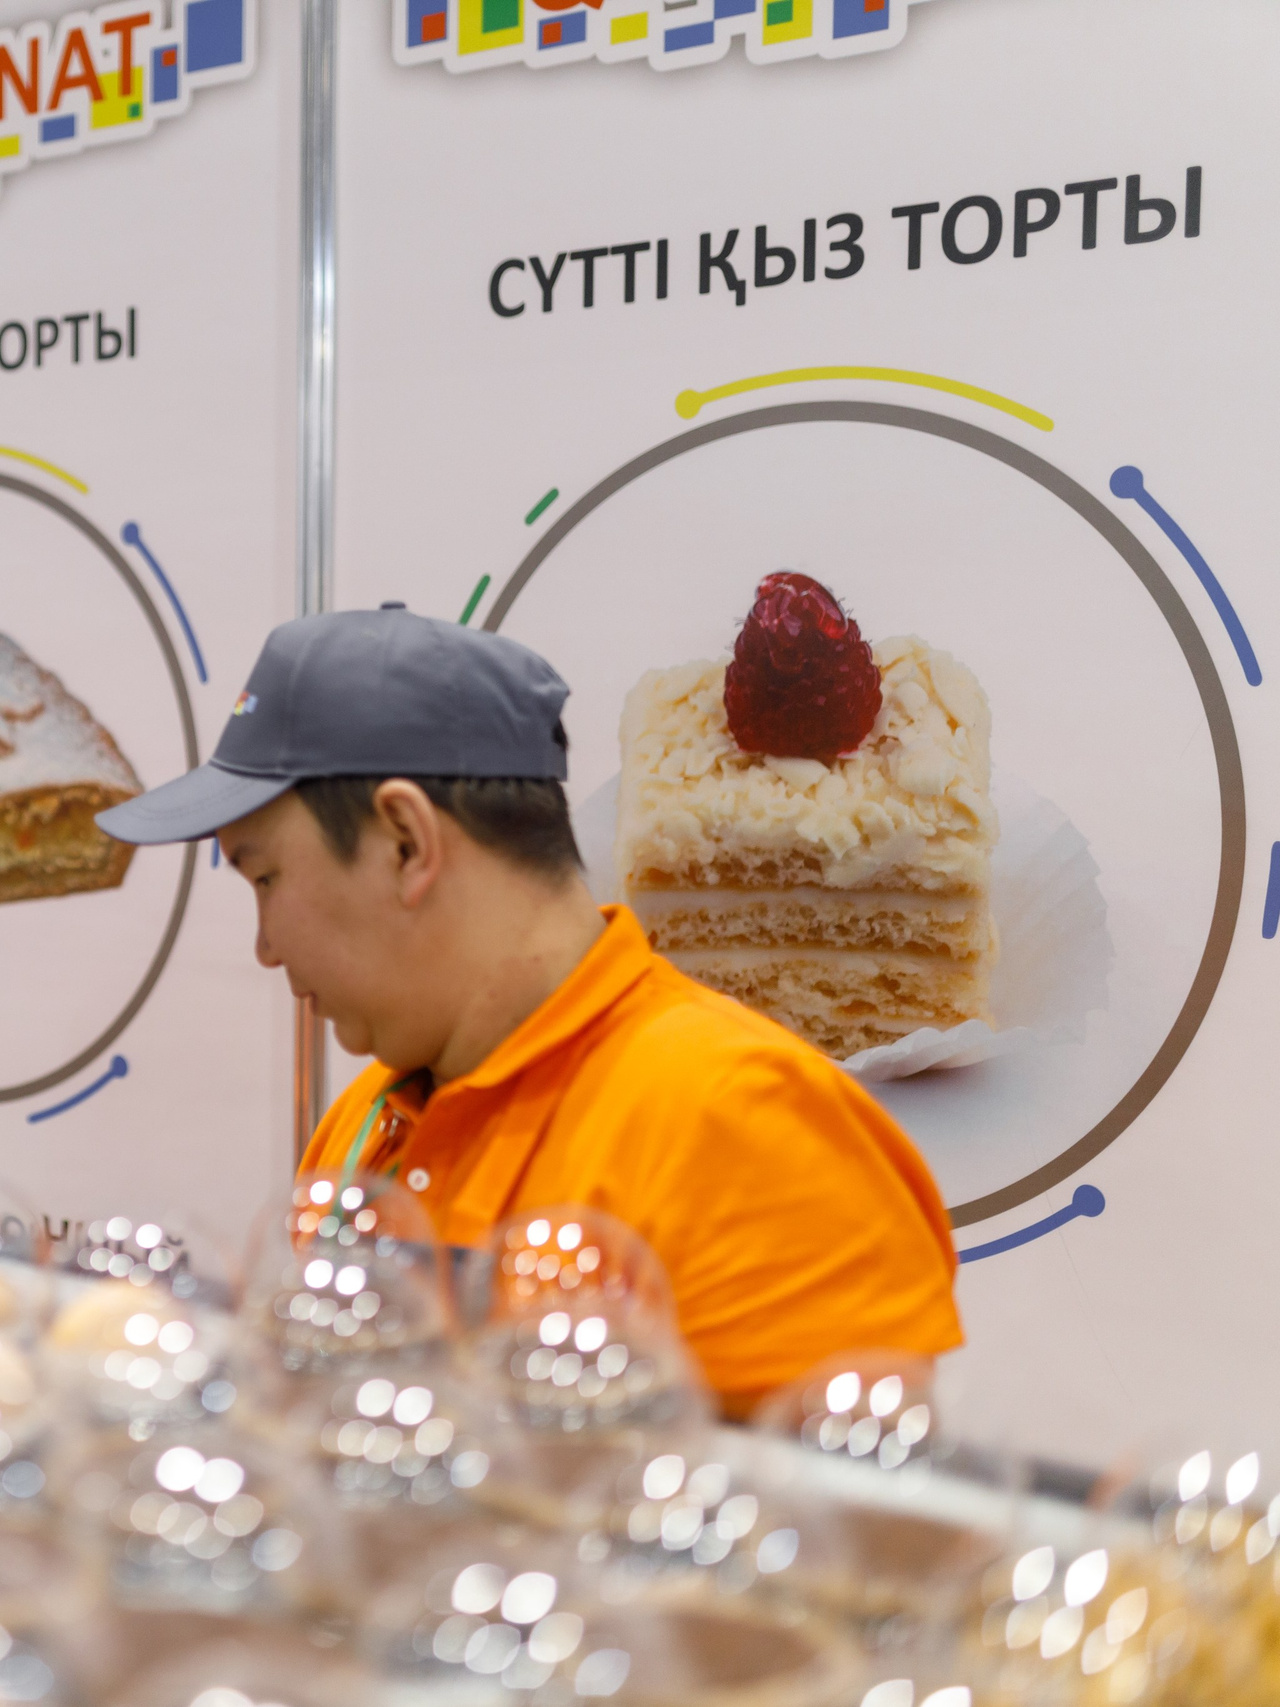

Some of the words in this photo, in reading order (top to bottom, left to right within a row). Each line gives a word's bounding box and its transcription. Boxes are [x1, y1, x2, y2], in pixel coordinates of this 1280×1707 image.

[487, 238, 668, 319] СҮТТІ
[697, 211, 866, 306] ҚЫЗ
[890, 165, 1203, 270] ТОРТЫ
